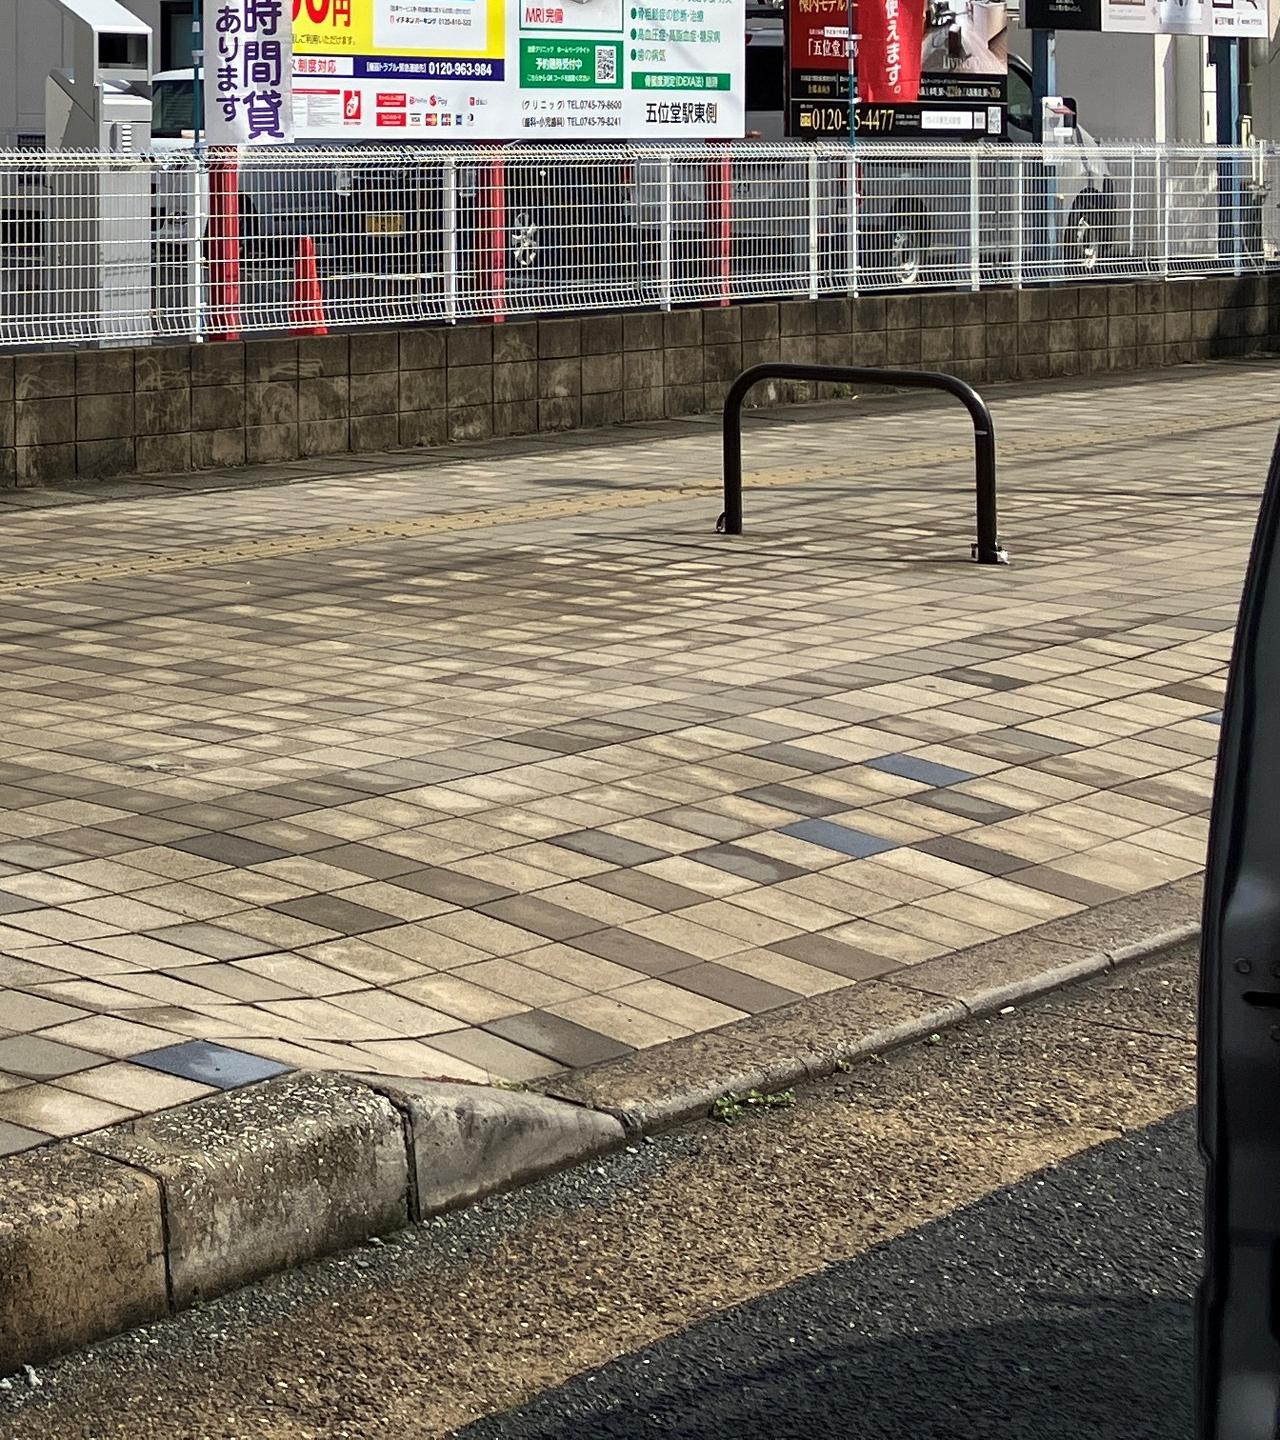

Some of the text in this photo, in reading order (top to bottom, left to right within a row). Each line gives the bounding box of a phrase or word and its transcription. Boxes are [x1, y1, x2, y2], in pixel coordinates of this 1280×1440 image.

[215, 5, 241, 122] あります
[428, 61, 492, 77] 0120-963-984
[645, 101, 718, 124] 五位堂駅東側
